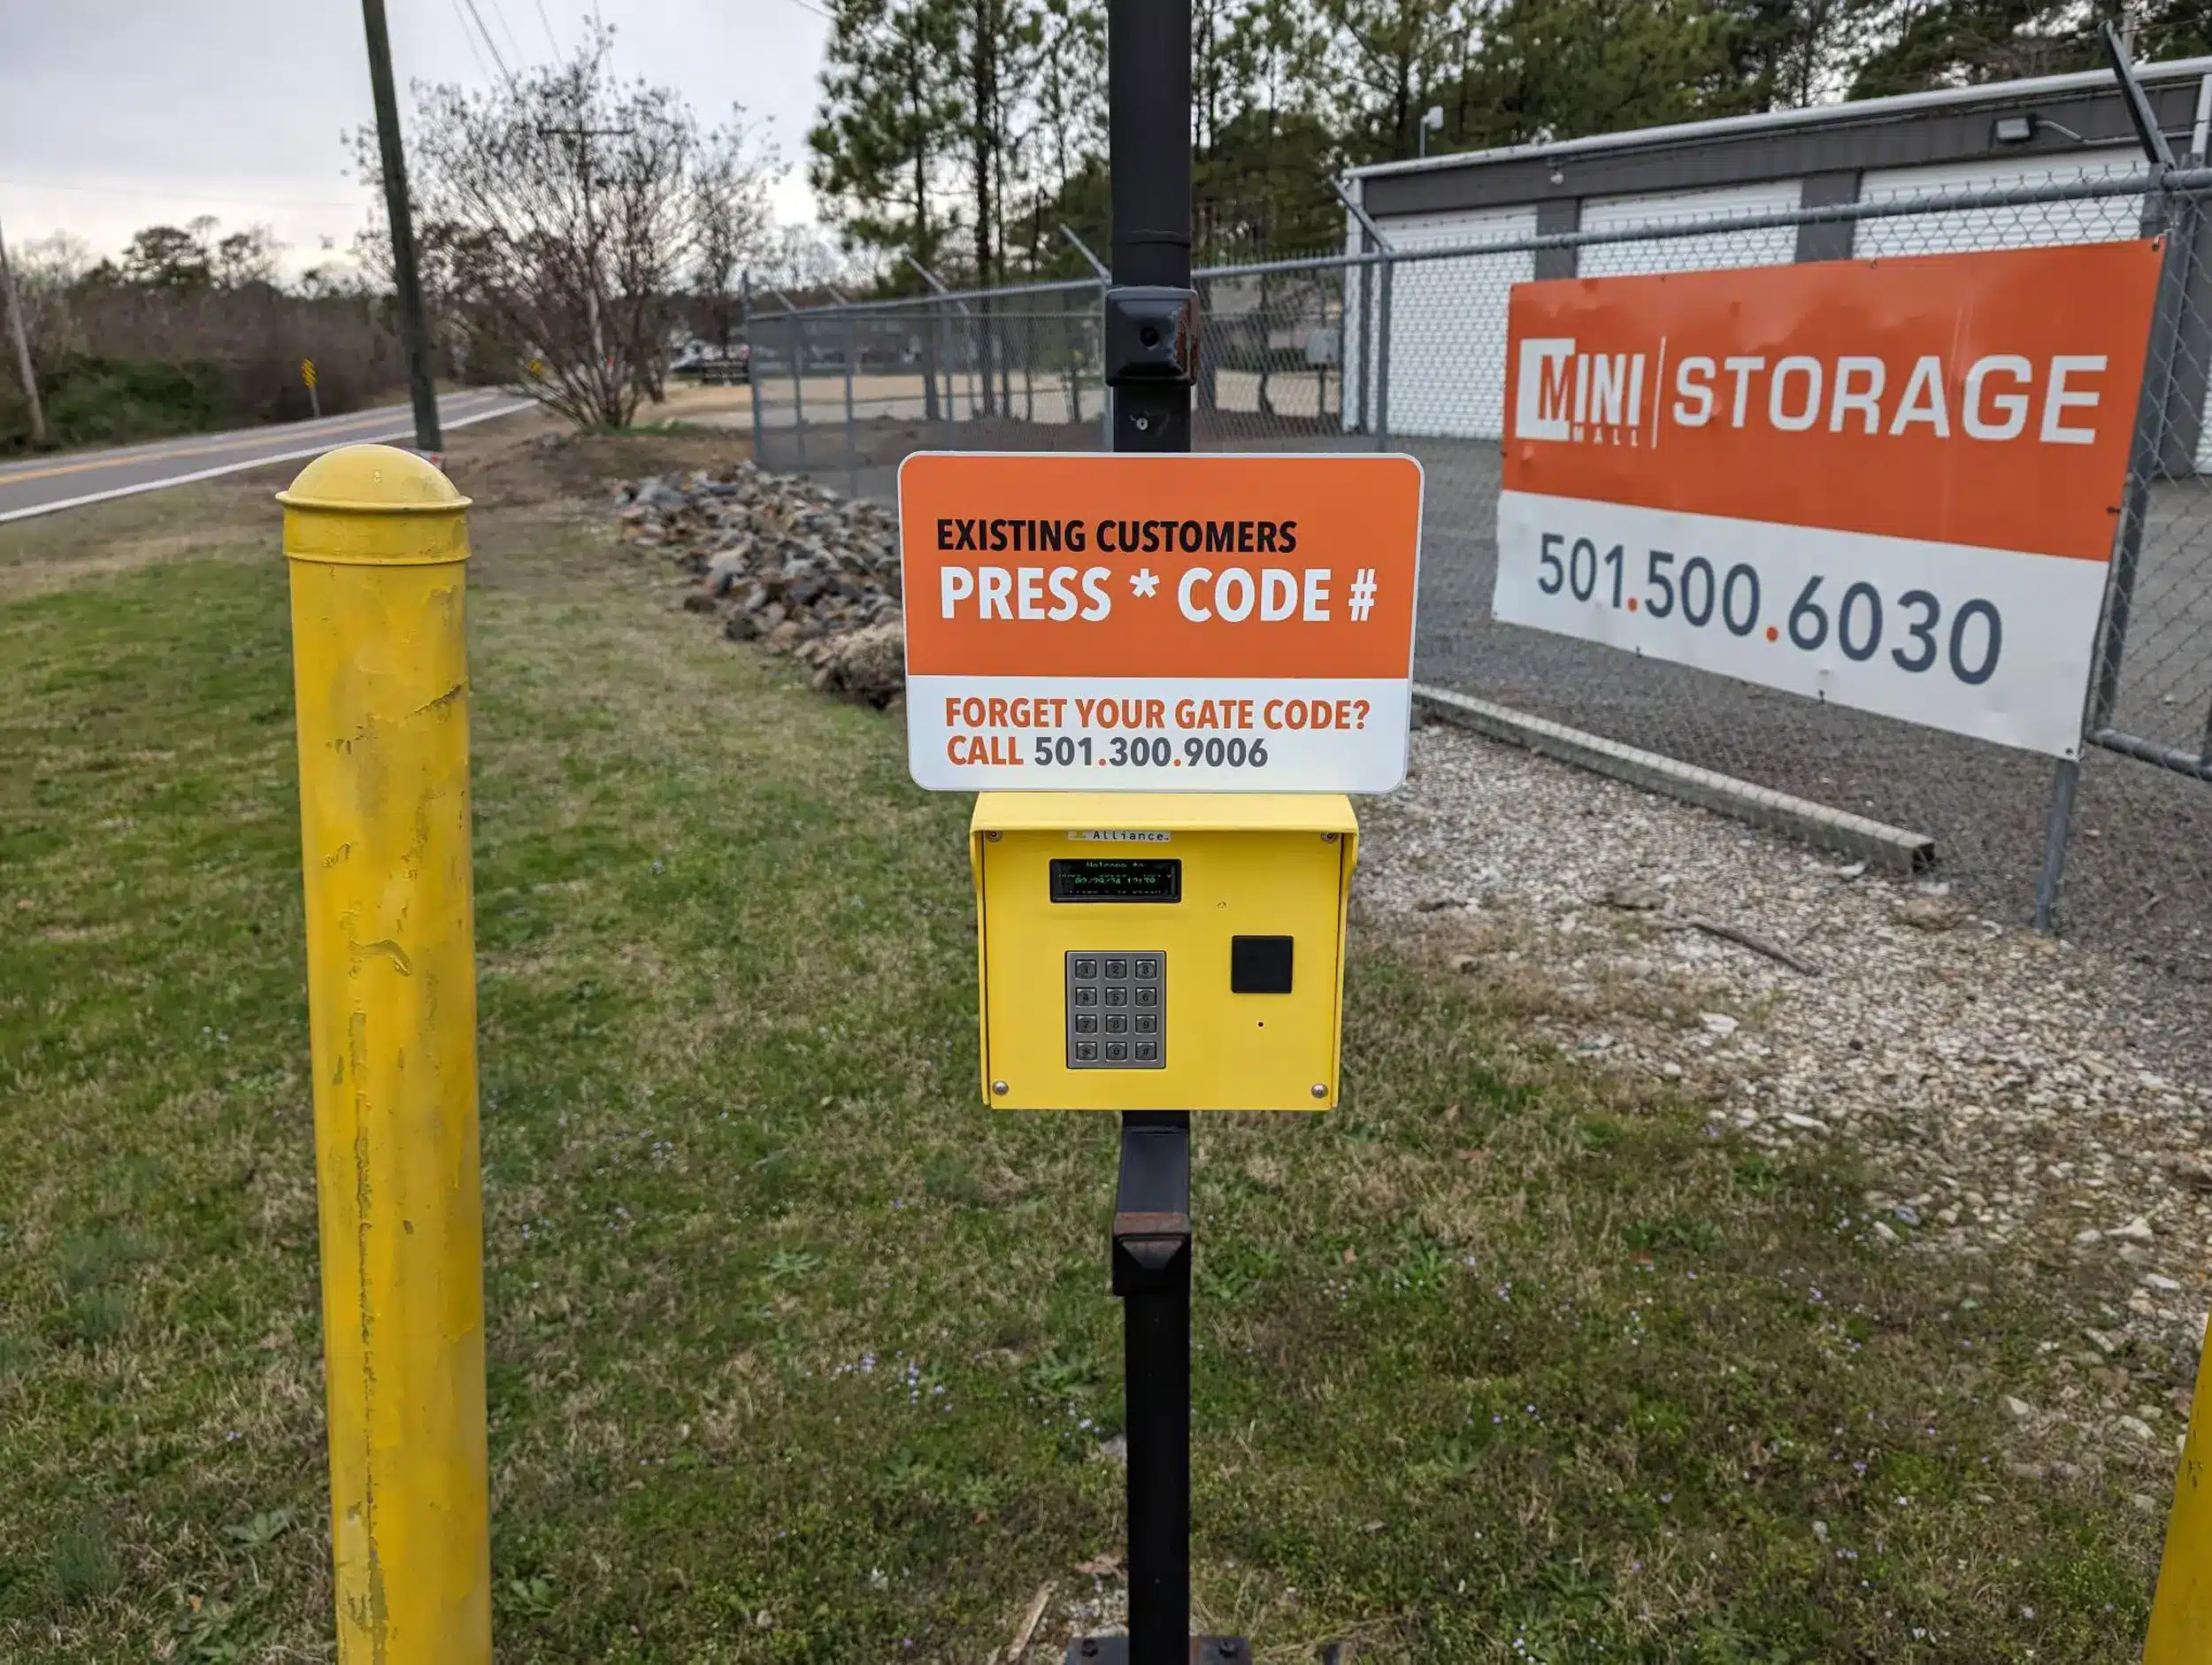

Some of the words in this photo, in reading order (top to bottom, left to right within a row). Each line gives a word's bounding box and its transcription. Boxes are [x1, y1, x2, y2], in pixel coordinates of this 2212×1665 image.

[1516, 338, 1646, 441] MINI
[1673, 354, 2108, 444] STORAGE
[1572, 425, 1639, 448] MALL
[937, 519, 1086, 552] EXISTING
[1096, 520, 1297, 553] CUSTOMERS
[941, 567, 1111, 621] PRESS
[1179, 568, 1331, 622] CODE
[1348, 569, 1377, 621] #
[1537, 532, 2002, 685] 501.500.6030
[946, 697, 1067, 729] FORGET
[1075, 698, 1165, 730] YOUR
[1174, 700, 1254, 730] GATE
[1263, 700, 1371, 730] CODE?
[948, 735, 1024, 766] CALL
[1033, 736, 1269, 767] 501.300.9006
